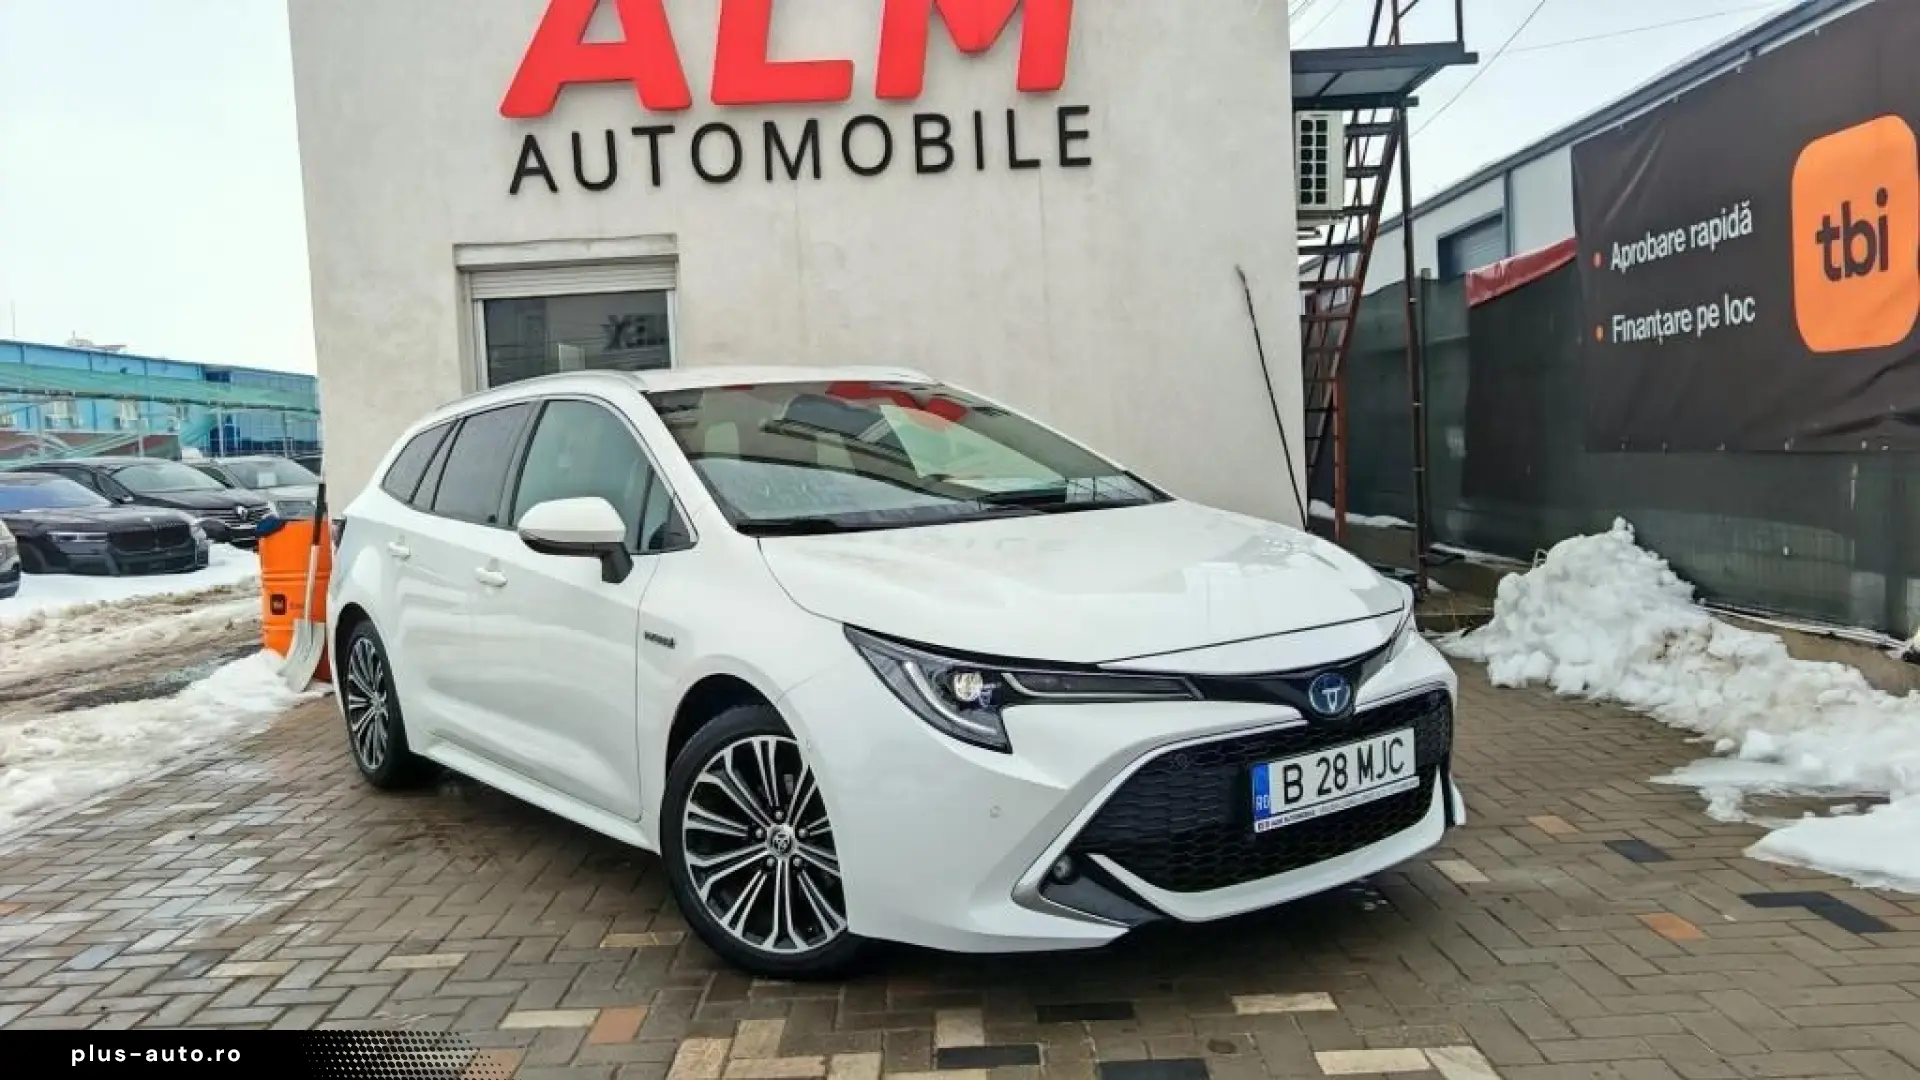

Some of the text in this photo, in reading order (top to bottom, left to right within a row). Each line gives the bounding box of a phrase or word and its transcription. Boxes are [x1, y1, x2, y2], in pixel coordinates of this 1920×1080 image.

[500, 0, 1075, 119] ALM
[509, 104, 1092, 195] AUTOMOBILE
[1610, 200, 1754, 273] Aprobare rapidă
[1814, 187, 1889, 282] tbi
[1696, 306, 1721, 338] pe
[1724, 294, 1756, 325] loc
[1283, 764, 1304, 805] B
[1315, 753, 1348, 797] 28
[1357, 737, 1405, 785] MJC
